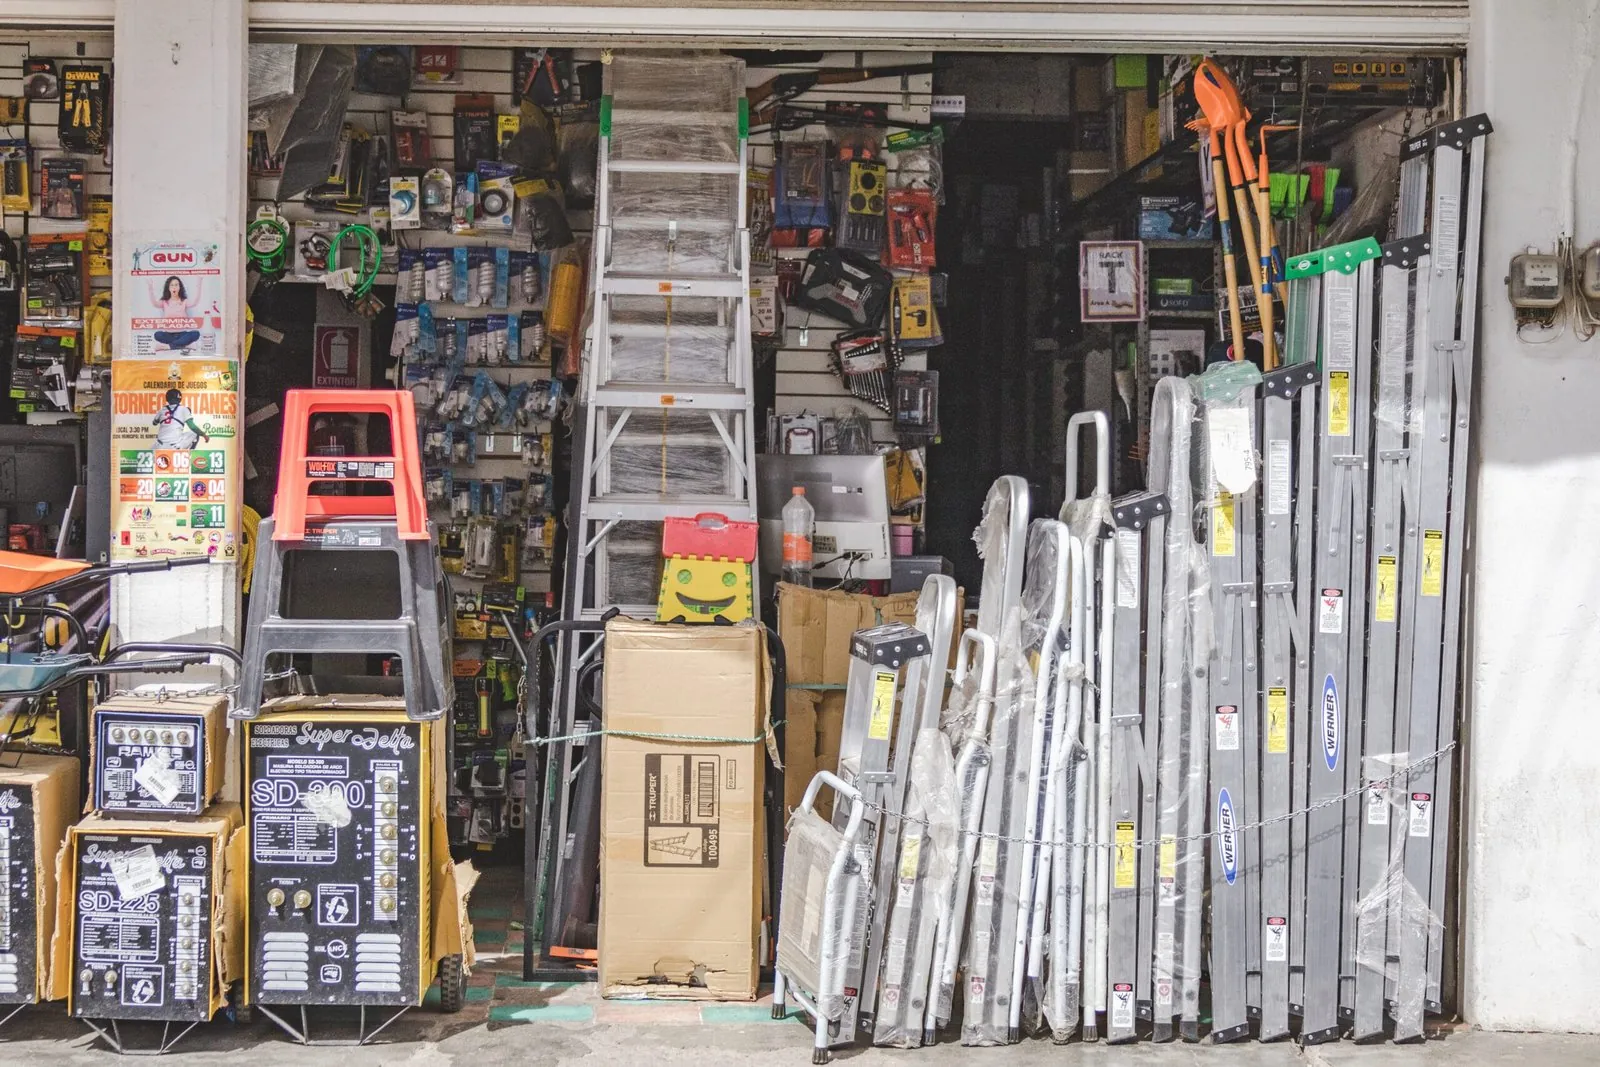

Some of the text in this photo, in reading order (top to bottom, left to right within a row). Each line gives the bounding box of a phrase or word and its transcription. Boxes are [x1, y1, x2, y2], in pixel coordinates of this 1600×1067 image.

[1098, 261, 1125, 294] T
[317, 376, 356, 385] EXTINTOR
[203, 423, 235, 434] Romita
[137, 452, 153, 468] 23
[173, 452, 189, 468] 06
[209, 452, 223, 468] 13
[137, 479, 153, 495] 20
[174, 480, 188, 496] 27
[208, 480, 225, 496] 04
[210, 506, 223, 522] 11
[251, 738, 290, 748] ELECTRICAS
[254, 725, 297, 735] SOLDADORAS
[296, 722, 352, 751] Super
[709, 829, 717, 861] 100495
